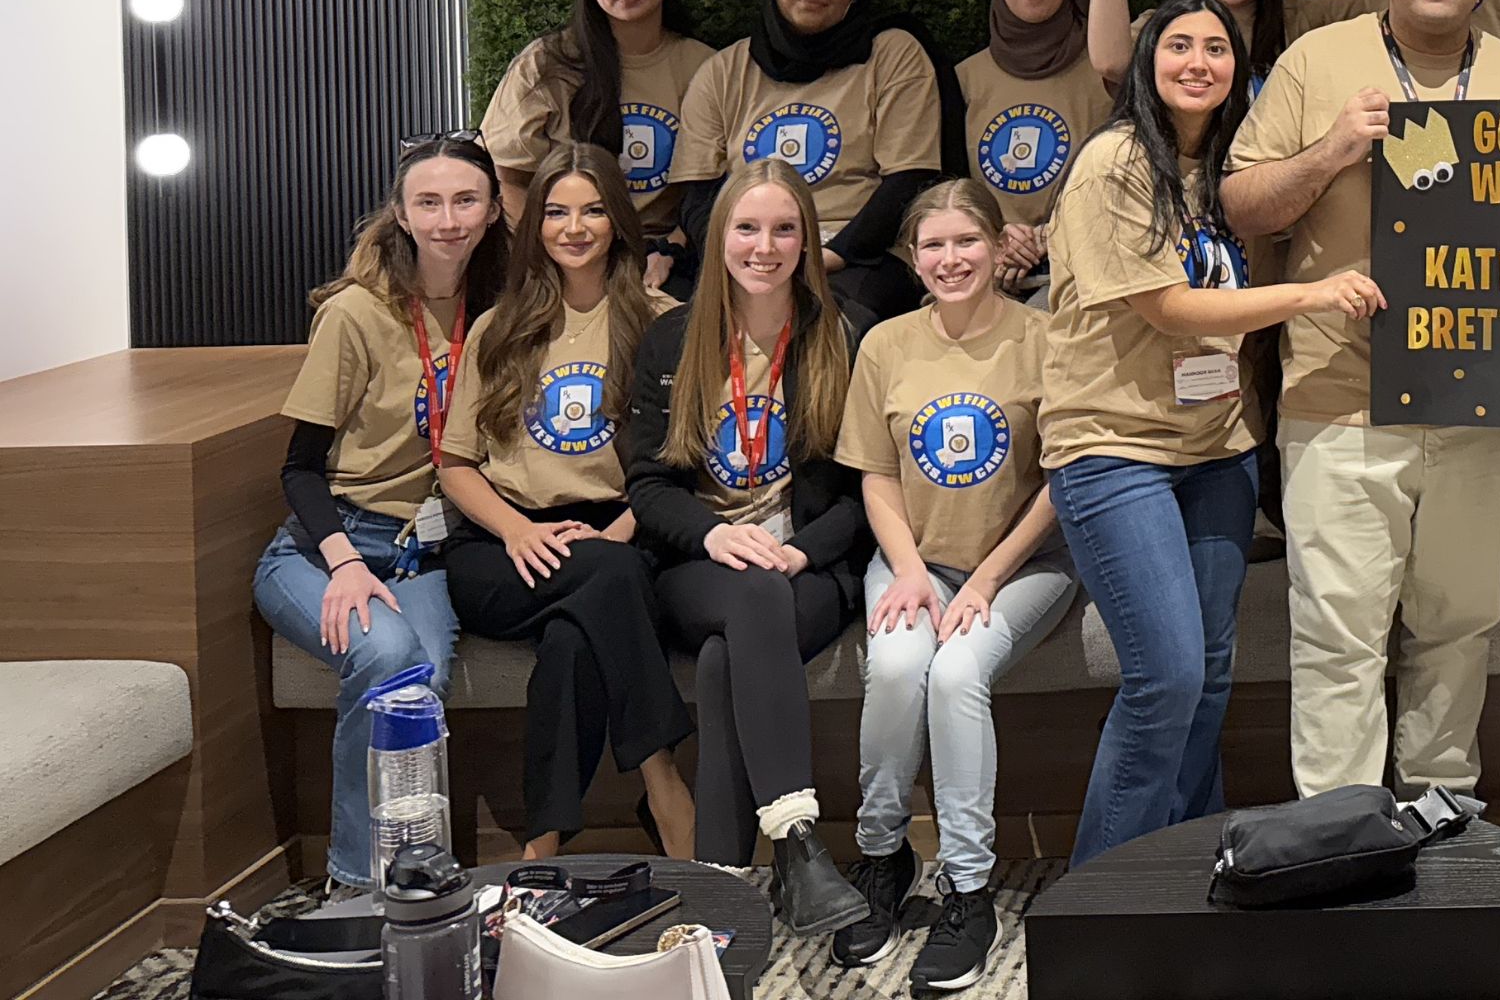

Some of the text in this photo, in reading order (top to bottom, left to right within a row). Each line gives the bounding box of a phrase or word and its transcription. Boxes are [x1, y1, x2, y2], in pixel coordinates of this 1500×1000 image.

[641, 105, 667, 121] FIX
[747, 105, 839, 142] CAN WE FIX IT?
[982, 106, 1069, 142] CAN WE FIX IT?
[804, 152, 836, 184] CAN!
[982, 158, 1063, 191] YES, UW CAN!
[554, 364, 580, 378] WE
[912, 395, 1007, 435] CAN WE FIX IT?
[530, 421, 615, 452] YES, UW CAN
[918, 447, 1006, 485] YES, UW CAN!
